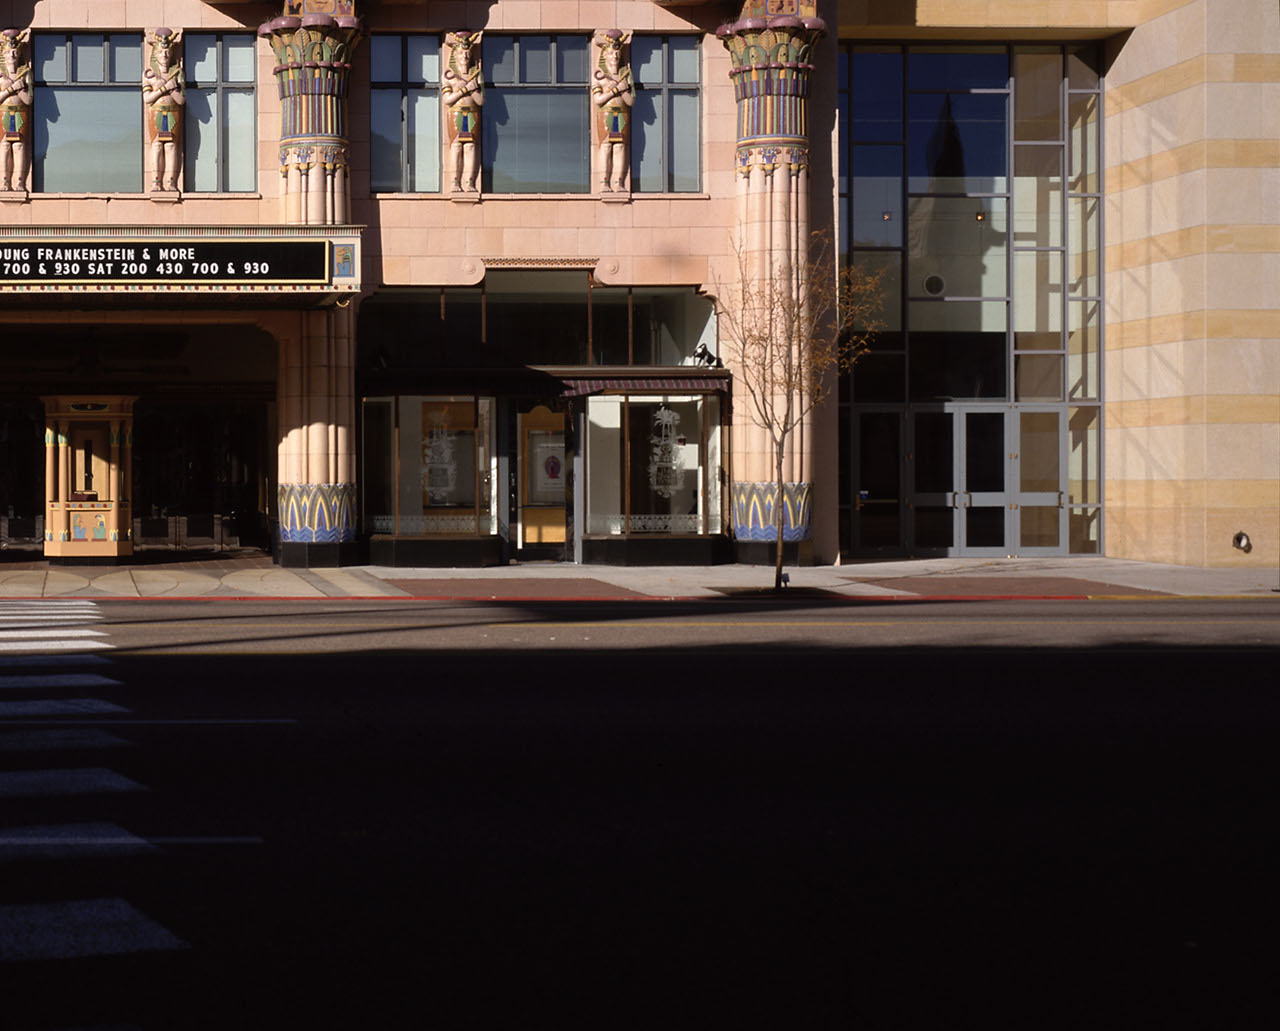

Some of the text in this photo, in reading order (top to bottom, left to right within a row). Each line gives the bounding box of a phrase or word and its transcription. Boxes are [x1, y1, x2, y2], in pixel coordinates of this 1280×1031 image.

[37, 248, 135, 260] FRANKENSTEIN
[142, 248, 151, 260] &
[159, 248, 195, 260] MORE
[3, 263, 31, 275] 700
[38, 263, 47, 275] &
[54, 263, 80, 275] 930
[87, 263, 113, 275] SAT
[121, 263, 148, 275] 200
[156, 263, 183, 275] 430
[191, 263, 219, 275] 700
[227, 263, 236, 275] &
[243, 263, 270, 275] 930
